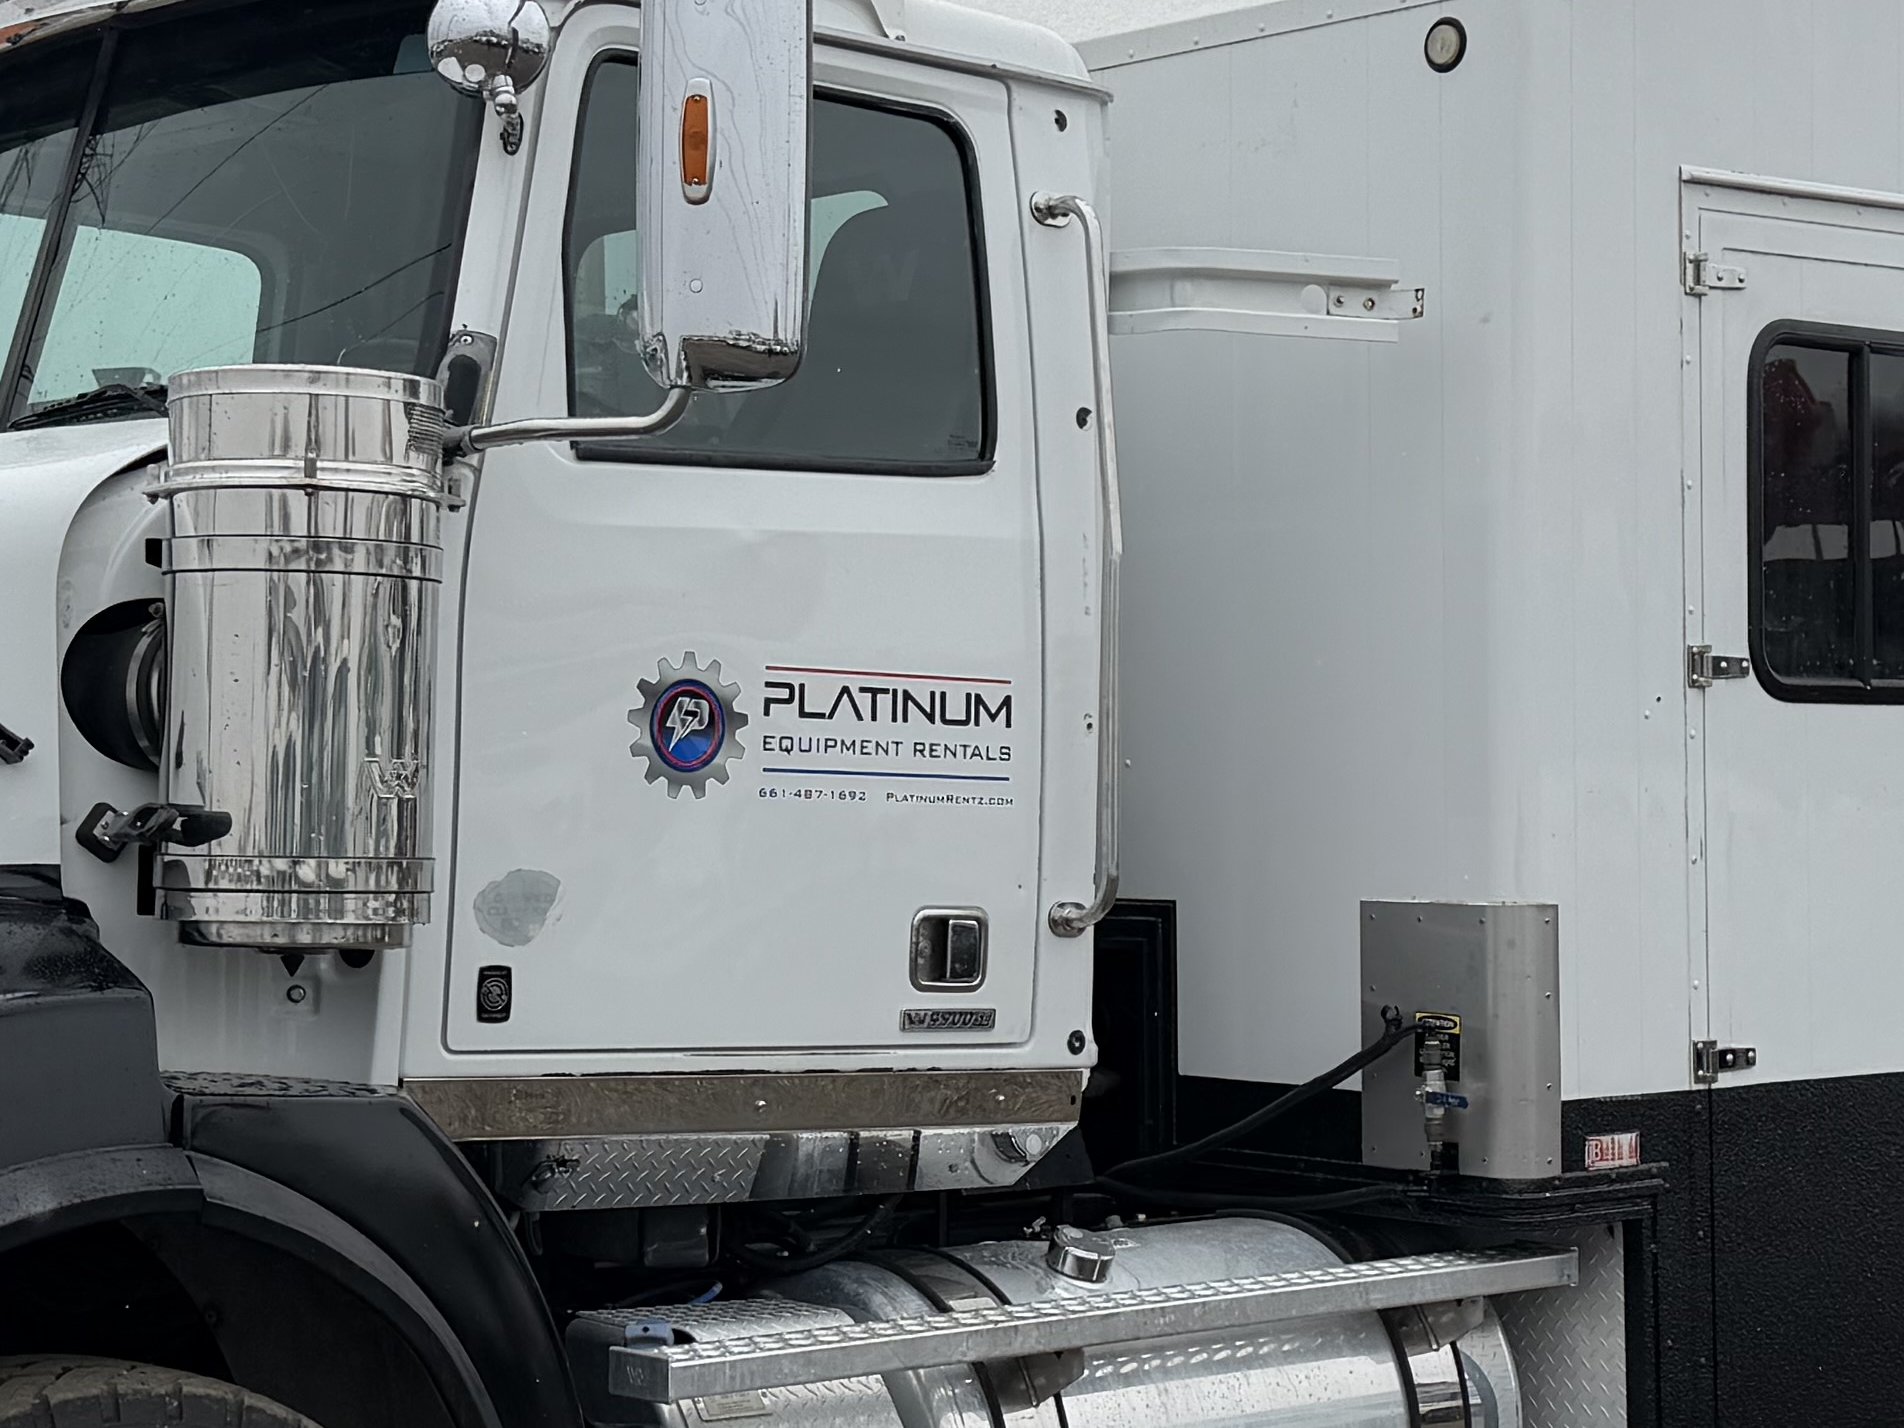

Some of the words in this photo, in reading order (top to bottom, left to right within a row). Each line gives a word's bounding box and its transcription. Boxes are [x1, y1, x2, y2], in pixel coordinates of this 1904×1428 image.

[763, 681, 1013, 728] PLATINUM
[762, 735, 902, 758] EQUIPMENT
[913, 740, 1013, 762] RENTALS
